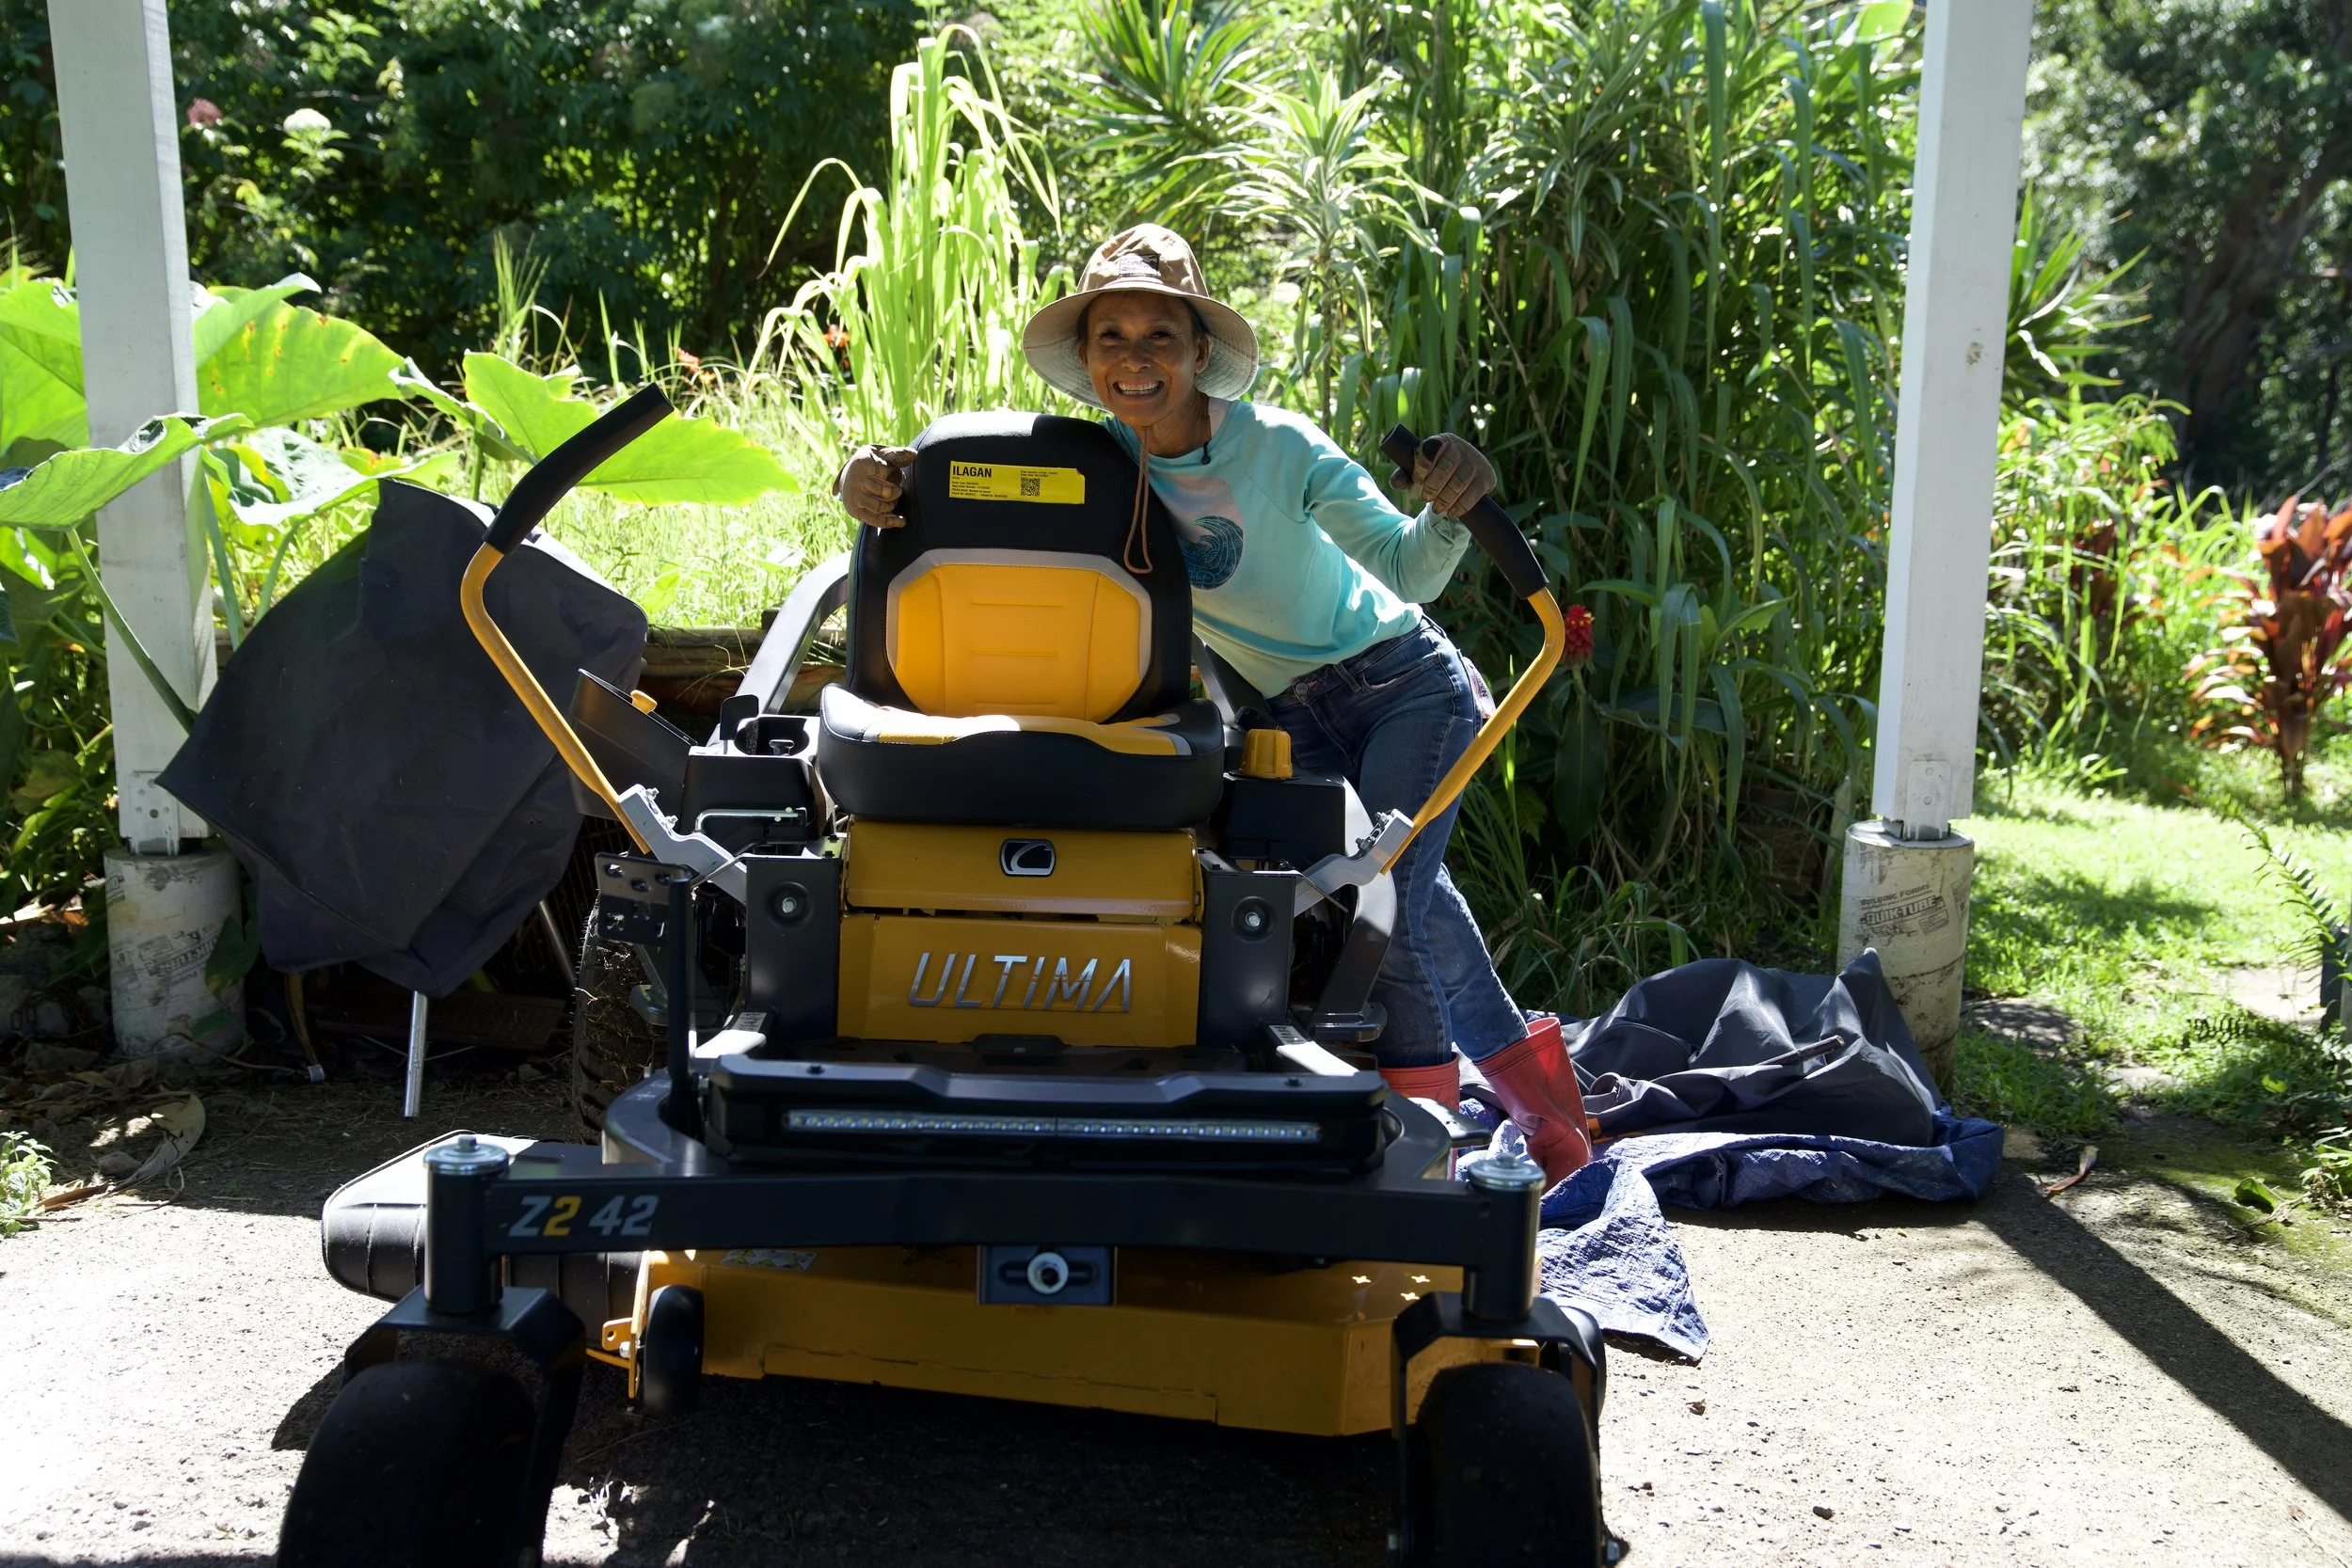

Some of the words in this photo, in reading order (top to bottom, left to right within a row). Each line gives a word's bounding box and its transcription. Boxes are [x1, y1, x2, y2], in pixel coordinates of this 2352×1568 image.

[952, 465, 993, 478] ILAGAN
[909, 952, 1130, 1013] ULTIMA
[508, 1196, 582, 1237] Z2
[588, 1195, 659, 1236] 42
